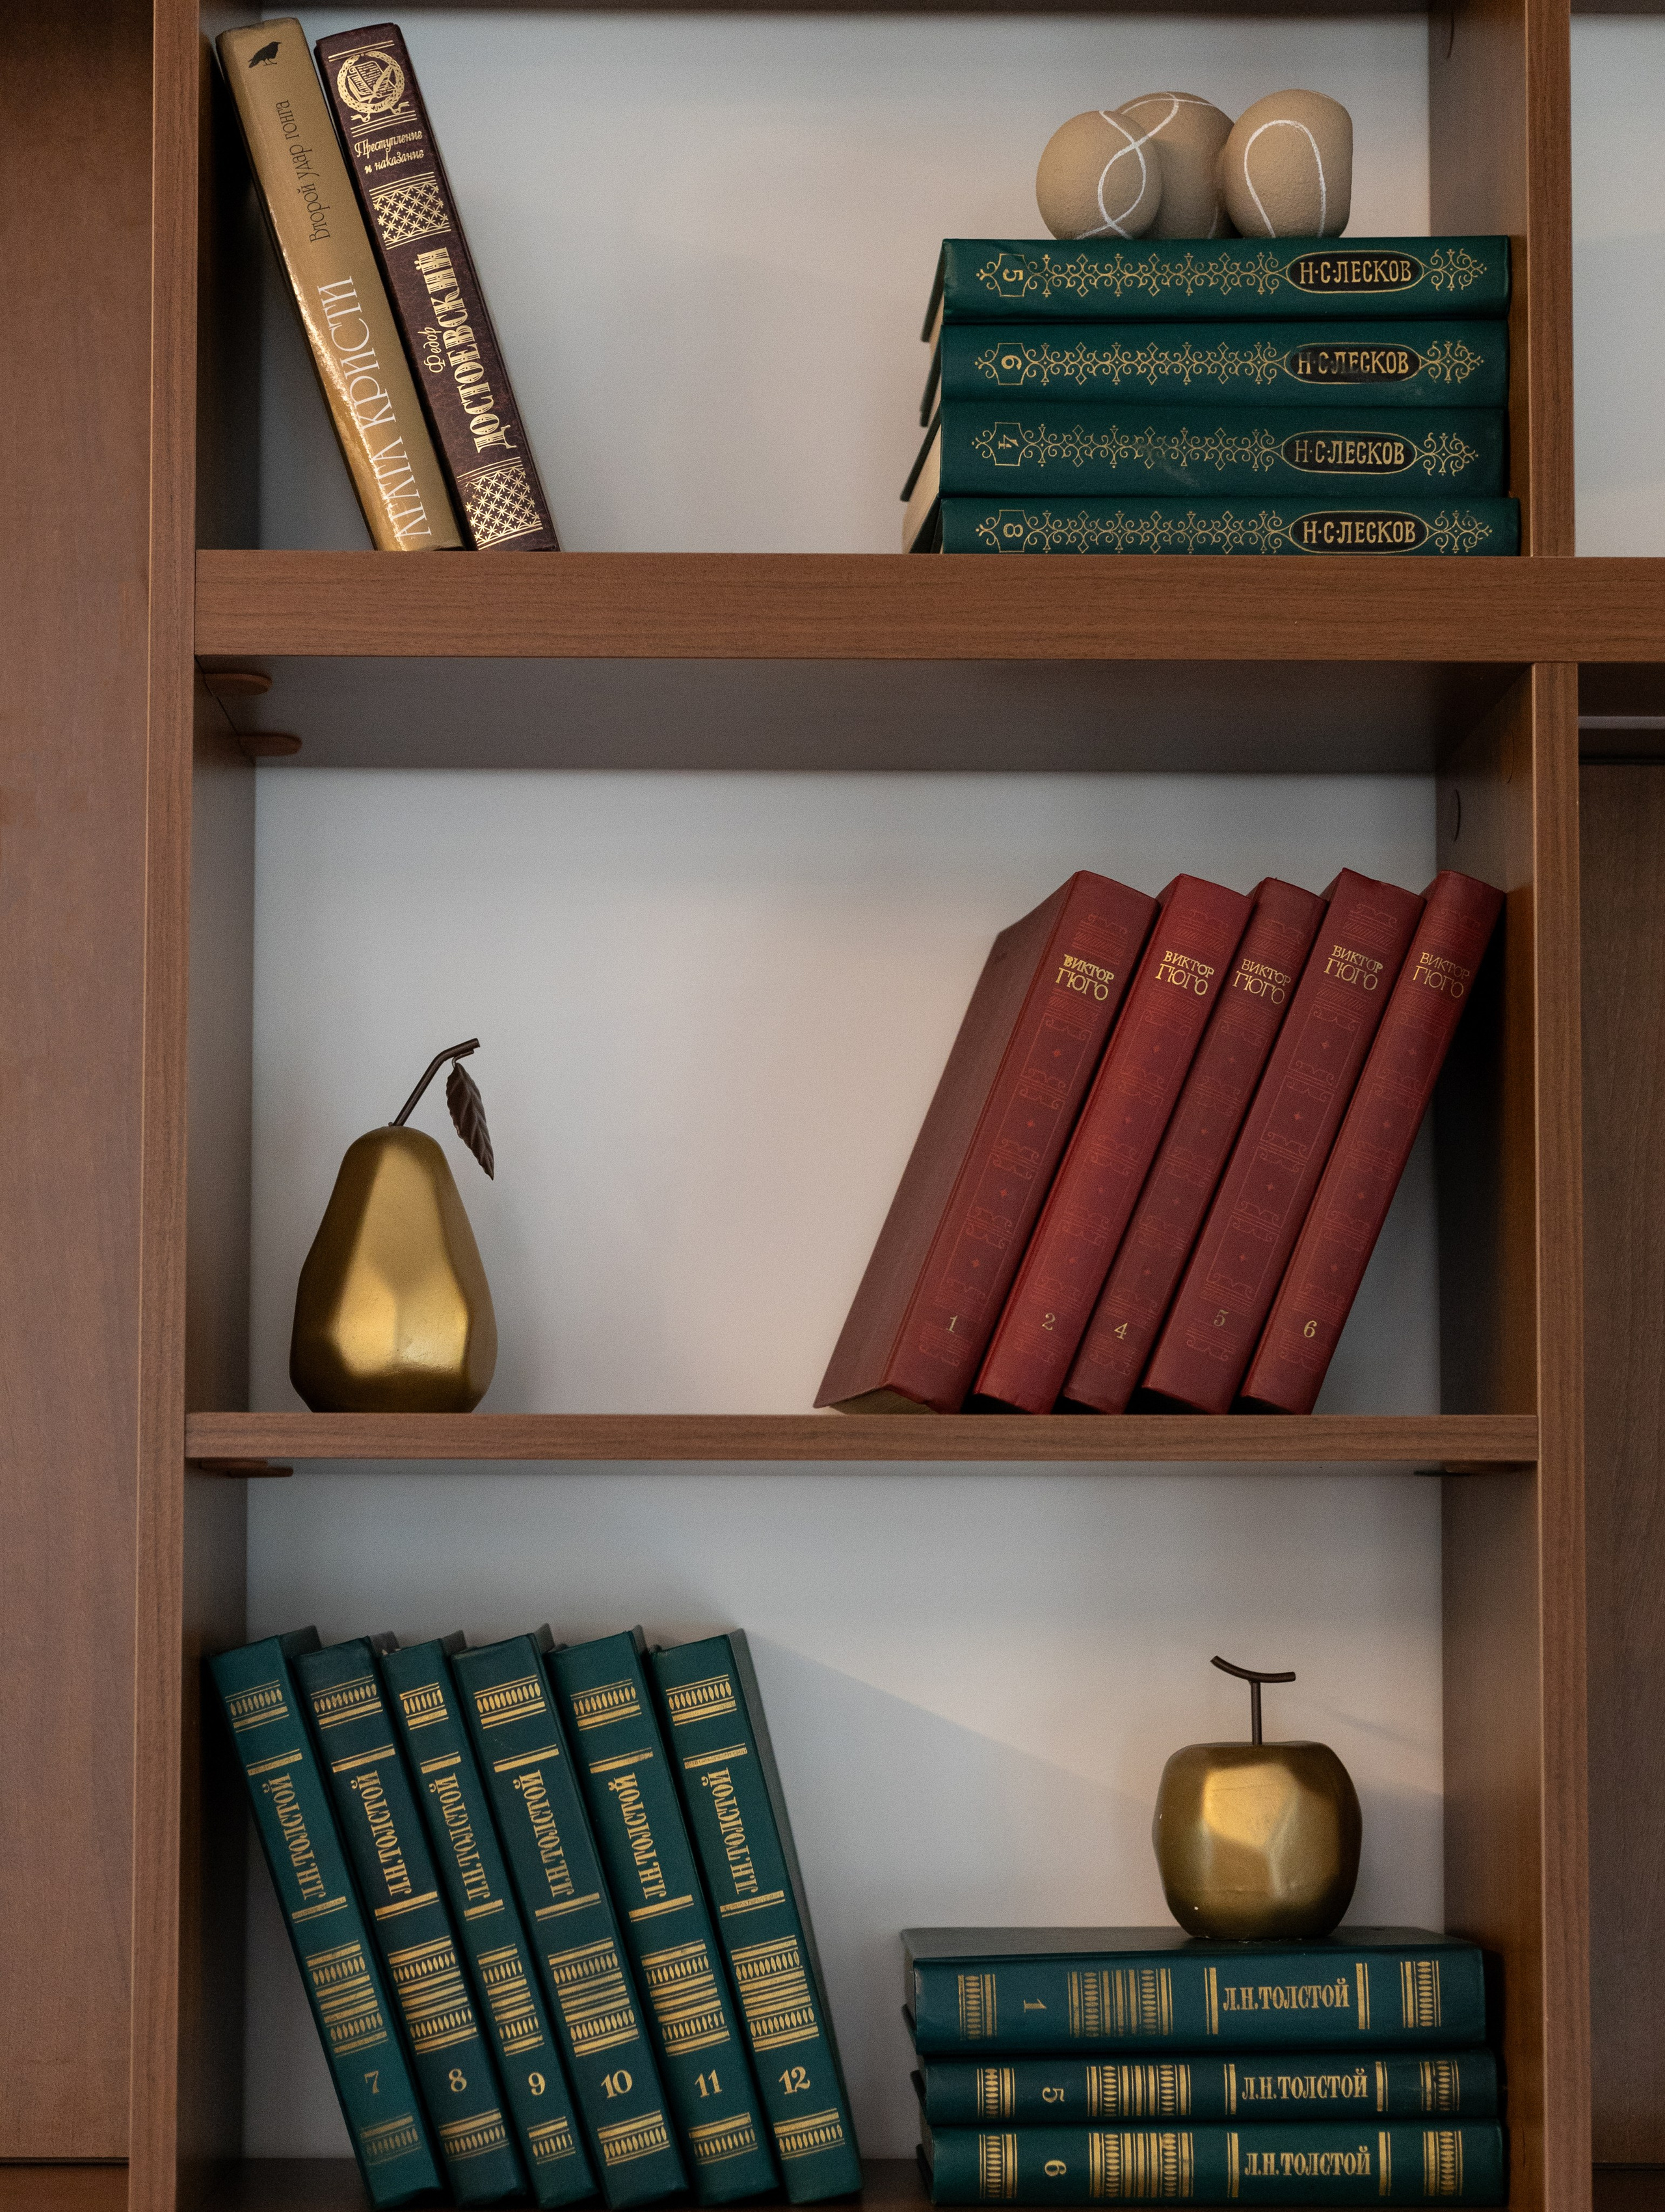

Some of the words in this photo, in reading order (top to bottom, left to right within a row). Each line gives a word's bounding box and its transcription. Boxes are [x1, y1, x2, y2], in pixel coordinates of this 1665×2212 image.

[276, 100, 299, 140] гонга
[354, 131, 423, 159] Преступление
[289, 144, 319, 180] удар
[364, 165, 372, 174] и
[375, 150, 424, 170] наказание
[297, 183, 330, 243] Второй
[1002, 268, 1023, 282] 5
[317, 276, 396, 430] КРИСТИ
[414, 247, 516, 453] ДОСТОЕВСКИЙ
[418, 327, 446, 373] Федор
[1001, 354, 1022, 370] 6
[998, 434, 1020, 449] 4
[370, 437, 431, 537] АГАТА
[1003, 524, 1023, 539] 8
[1063, 954, 1114, 984] ВИКТОР
[1163, 950, 1214, 978] ВИКТОР
[1241, 959, 1291, 986] ВИКТОР
[1331, 945, 1383, 974] ВИКТОР
[1420, 952, 1470, 979] ВИКТОР
[1056, 967, 1108, 1000] ГЮГО
[1155, 963, 1208, 996] ГЮГО
[1232, 971, 1285, 1004] ГЮГО
[1324, 957, 1378, 991] ГЮГО
[1413, 965, 1464, 998] ГЮГО
[946, 1315, 958, 1333] 1
[1041, 1313, 1056, 1331] 2
[1113, 1322, 1128, 1340] 4
[1213, 1309, 1229, 1327] 5
[1303, 1320, 1318, 1338] 6
[1023, 1998, 1046, 2013] 1
[364, 2070, 380, 2094] 7
[449, 2068, 468, 2092] 8
[528, 2073, 546, 2096] 9
[601, 2070, 633, 2098] 10
[695, 2070, 723, 2098] 11
[779, 2066, 810, 2095] 12
[1042, 2086, 1065, 2103] 5
[1044, 2159, 1067, 2177] 6
